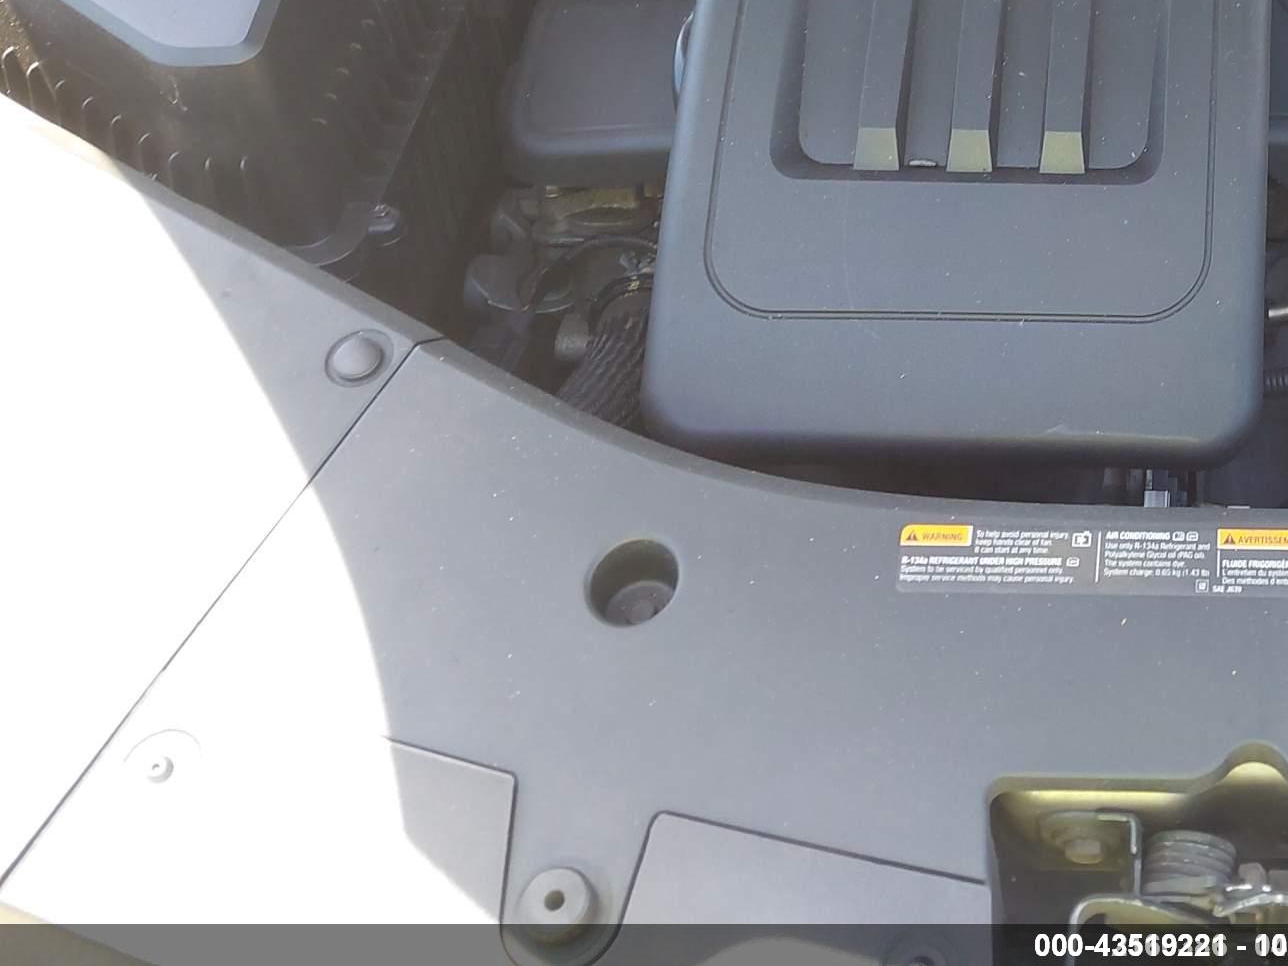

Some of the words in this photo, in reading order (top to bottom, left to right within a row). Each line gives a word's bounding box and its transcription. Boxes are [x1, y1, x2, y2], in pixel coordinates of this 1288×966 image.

[923, 532, 963, 540] WARNING
[985, 531, 1000, 539] help
[1020, 531, 1050, 540] personal
[1105, 531, 1119, 539] AIR
[1119, 532, 1171, 540] CONDITIONING
[994, 546, 1010, 554] start
[1119, 542, 1133, 551] only
[1134, 542, 1160, 550] R-134a
[1160, 543, 1197, 551] Refrigerant
[1146, 551, 1167, 559] Glycol
[929, 556, 978, 565] REFRIGERANT
[979, 557, 1005, 566] UNDER
[1005, 557, 1024, 566] HIGH
[1024, 557, 1062, 566] PRESSURE
[1118, 560, 1142, 568] system
[1222, 559, 1247, 569] FLUIDE
[901, 565, 926, 574] System
[1013, 567, 1048, 575] personnel
[1104, 568, 1128, 578] System
[1172, 569, 1181, 578] kg
[987, 575, 1002, 584] may
[1002, 575, 1024, 583] cause
[1024, 575, 1054, 584] personal
